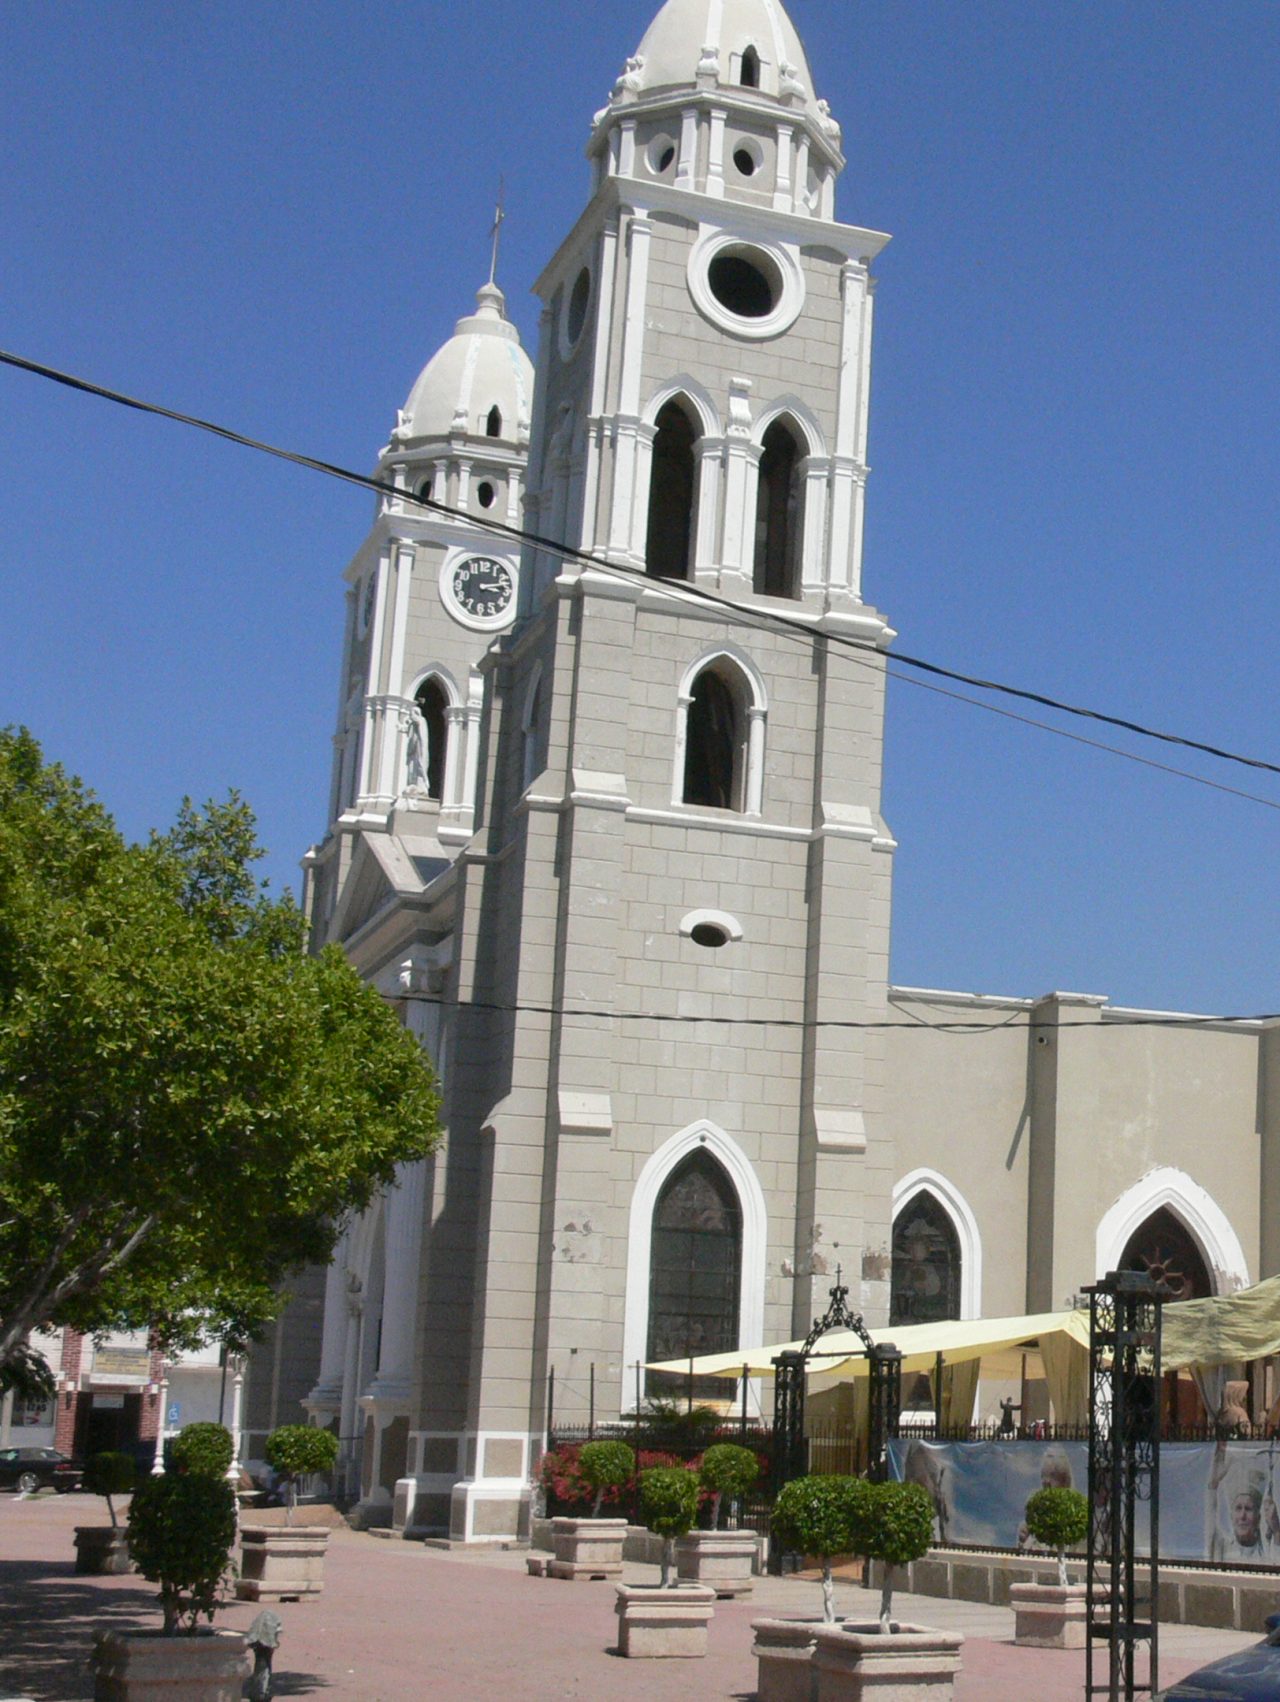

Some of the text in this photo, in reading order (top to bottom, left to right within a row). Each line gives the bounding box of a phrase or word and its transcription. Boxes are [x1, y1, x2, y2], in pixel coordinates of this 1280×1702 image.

[468, 560, 478, 574] 11
[479, 561, 491, 572] 12
[492, 564, 500, 577] 1
[456, 568, 470, 581] 10
[499, 573, 509, 584] 2
[454, 580, 462, 591] 9
[502, 584, 512, 596] 3
[457, 591, 464, 602] 8
[497, 597, 507, 607] 4
[466, 598, 474, 609] 7
[487, 602, 497, 615] 5
[476, 603, 484, 616] 6
